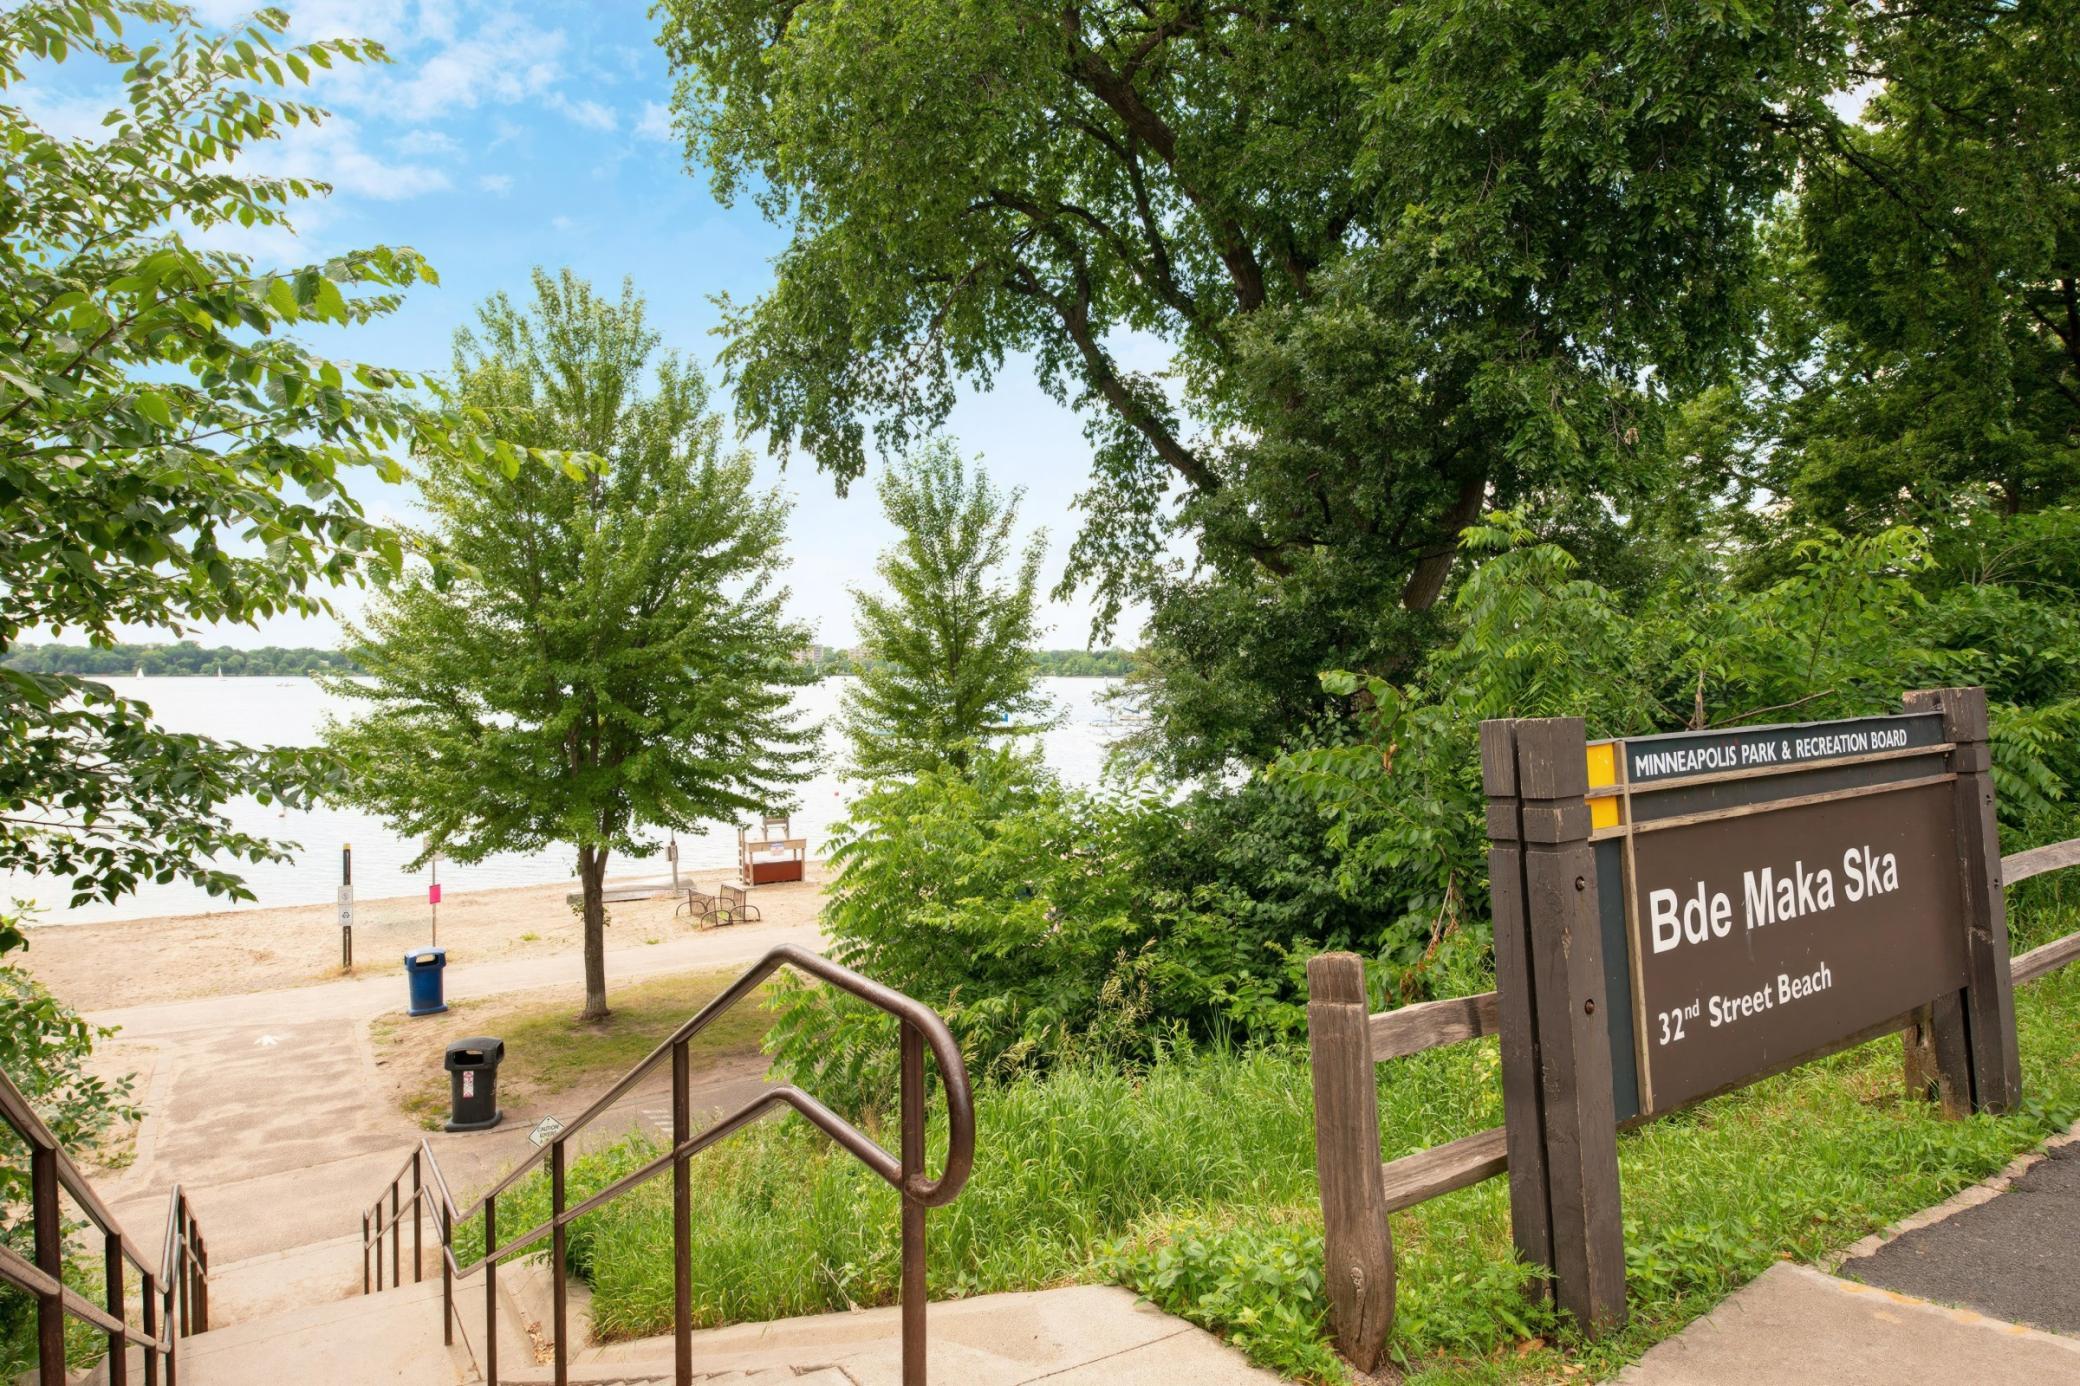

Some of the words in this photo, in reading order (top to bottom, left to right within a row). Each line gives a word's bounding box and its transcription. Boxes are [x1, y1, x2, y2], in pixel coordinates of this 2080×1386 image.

[1635, 746, 1737, 777] MINNEAPOLIS
[1741, 741, 1777, 764] PARK
[1782, 740, 1792, 760] &
[1796, 733, 1868, 758] RECREATION
[1871, 729, 1907, 749] BOARD
[1650, 882, 1732, 954] Bde
[1744, 861, 1835, 930] Maka
[1843, 846, 1899, 903] Ska
[1658, 998, 1700, 1046] 32nd
[1708, 983, 1773, 1028] Street
[1777, 963, 1832, 1005] Beach
